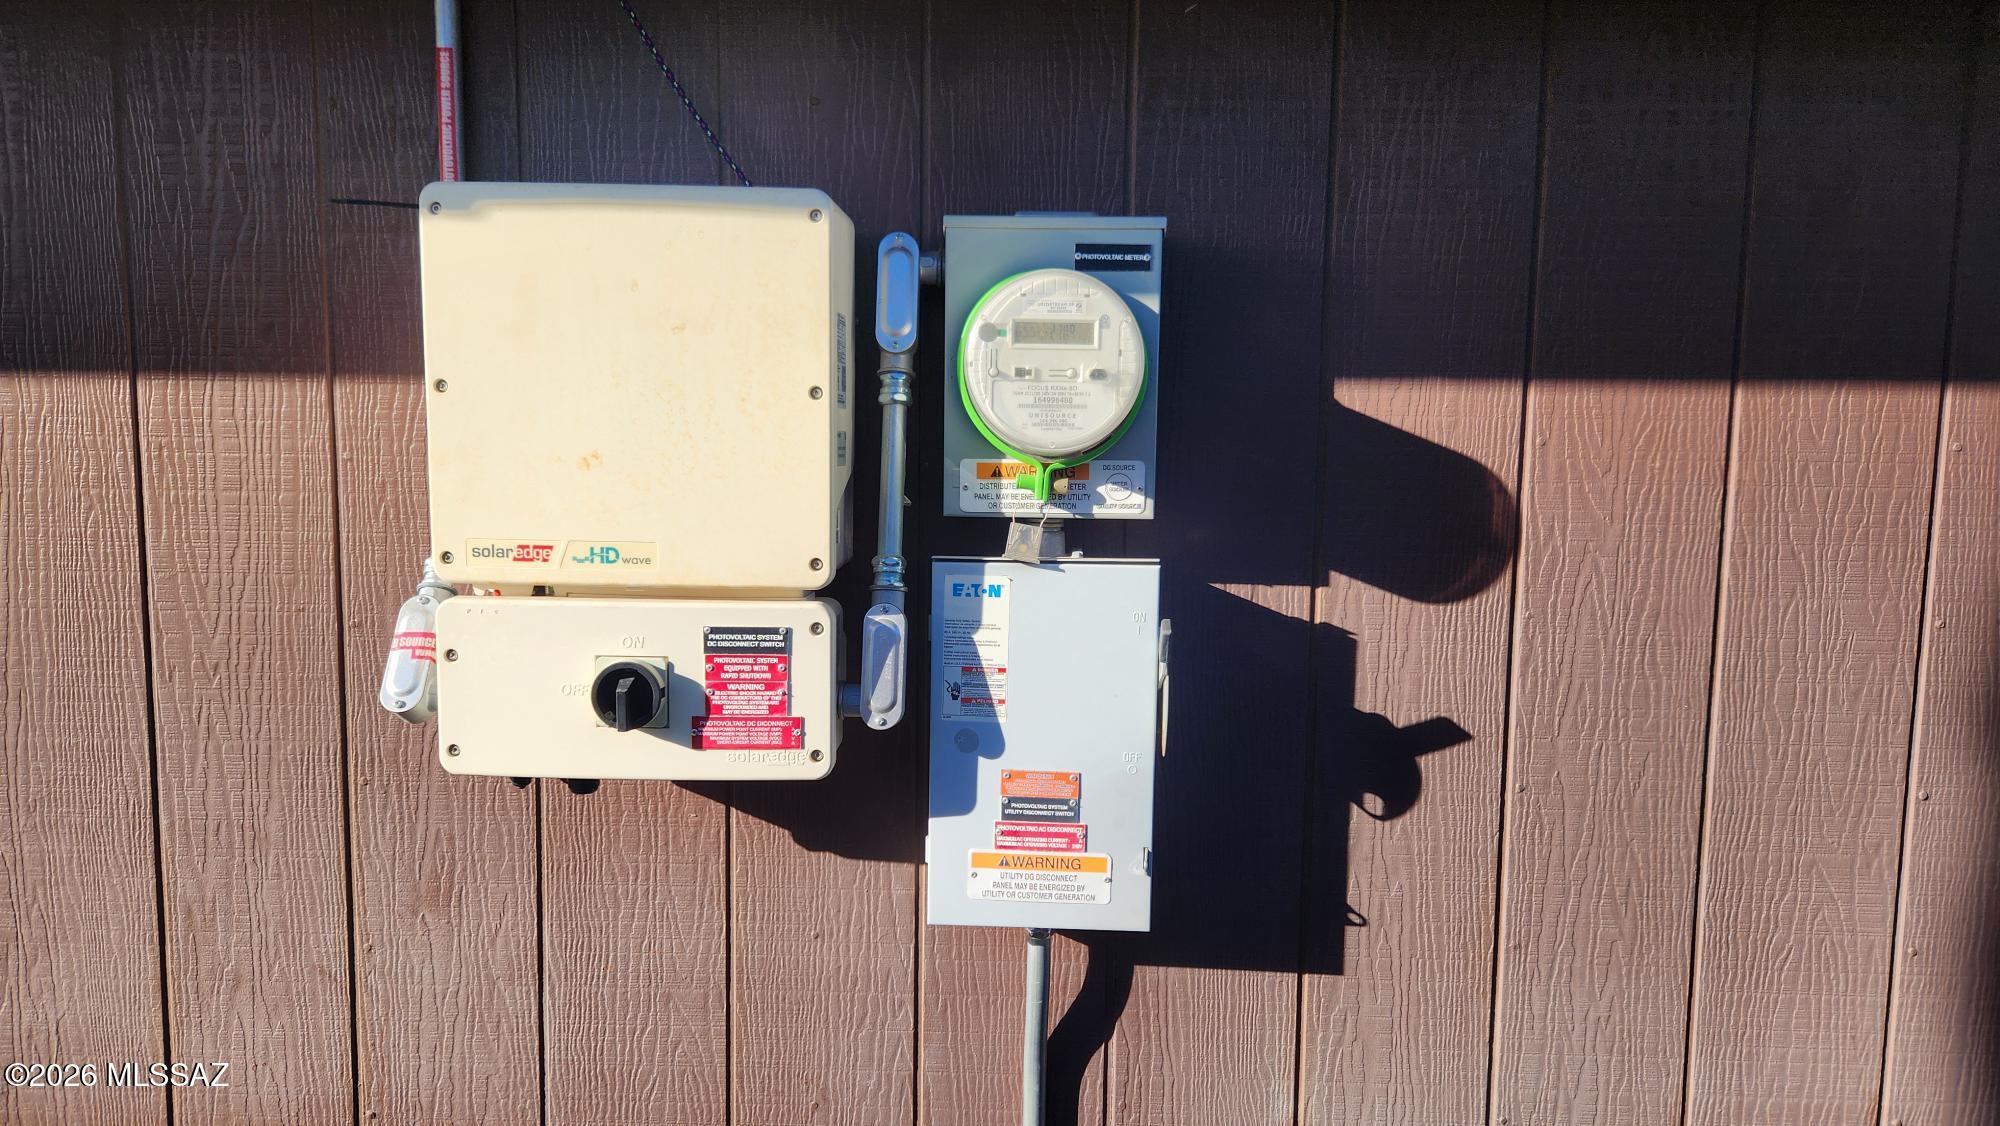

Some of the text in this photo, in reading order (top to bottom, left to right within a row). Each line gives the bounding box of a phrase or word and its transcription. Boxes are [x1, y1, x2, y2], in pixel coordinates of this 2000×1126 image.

[439, 51, 455, 182] OTOVOLTAIC POWER SOURCE
[1068, 492, 1092, 500] UTILITY
[998, 502, 1034, 510] CUSTOMER
[472, 544, 553, 562] solaredge
[622, 556, 652, 565] wave
[1133, 611, 1147, 624] ON
[622, 636, 646, 648] ON
[561, 684, 590, 696] OFF
[728, 750, 808, 766] solaredge
[1122, 752, 1142, 763] OFF
[1012, 856, 1081, 870] WARNING
[1036, 874, 1078, 882] DISCONNECT
[992, 882, 1012, 890] PANEL
[1040, 884, 1075, 892] ENERGIZED
[982, 890, 1005, 898] UTILITY
[1017, 892, 1053, 900] CUSTOMER
[1055, 892, 1096, 902] GENERATION
